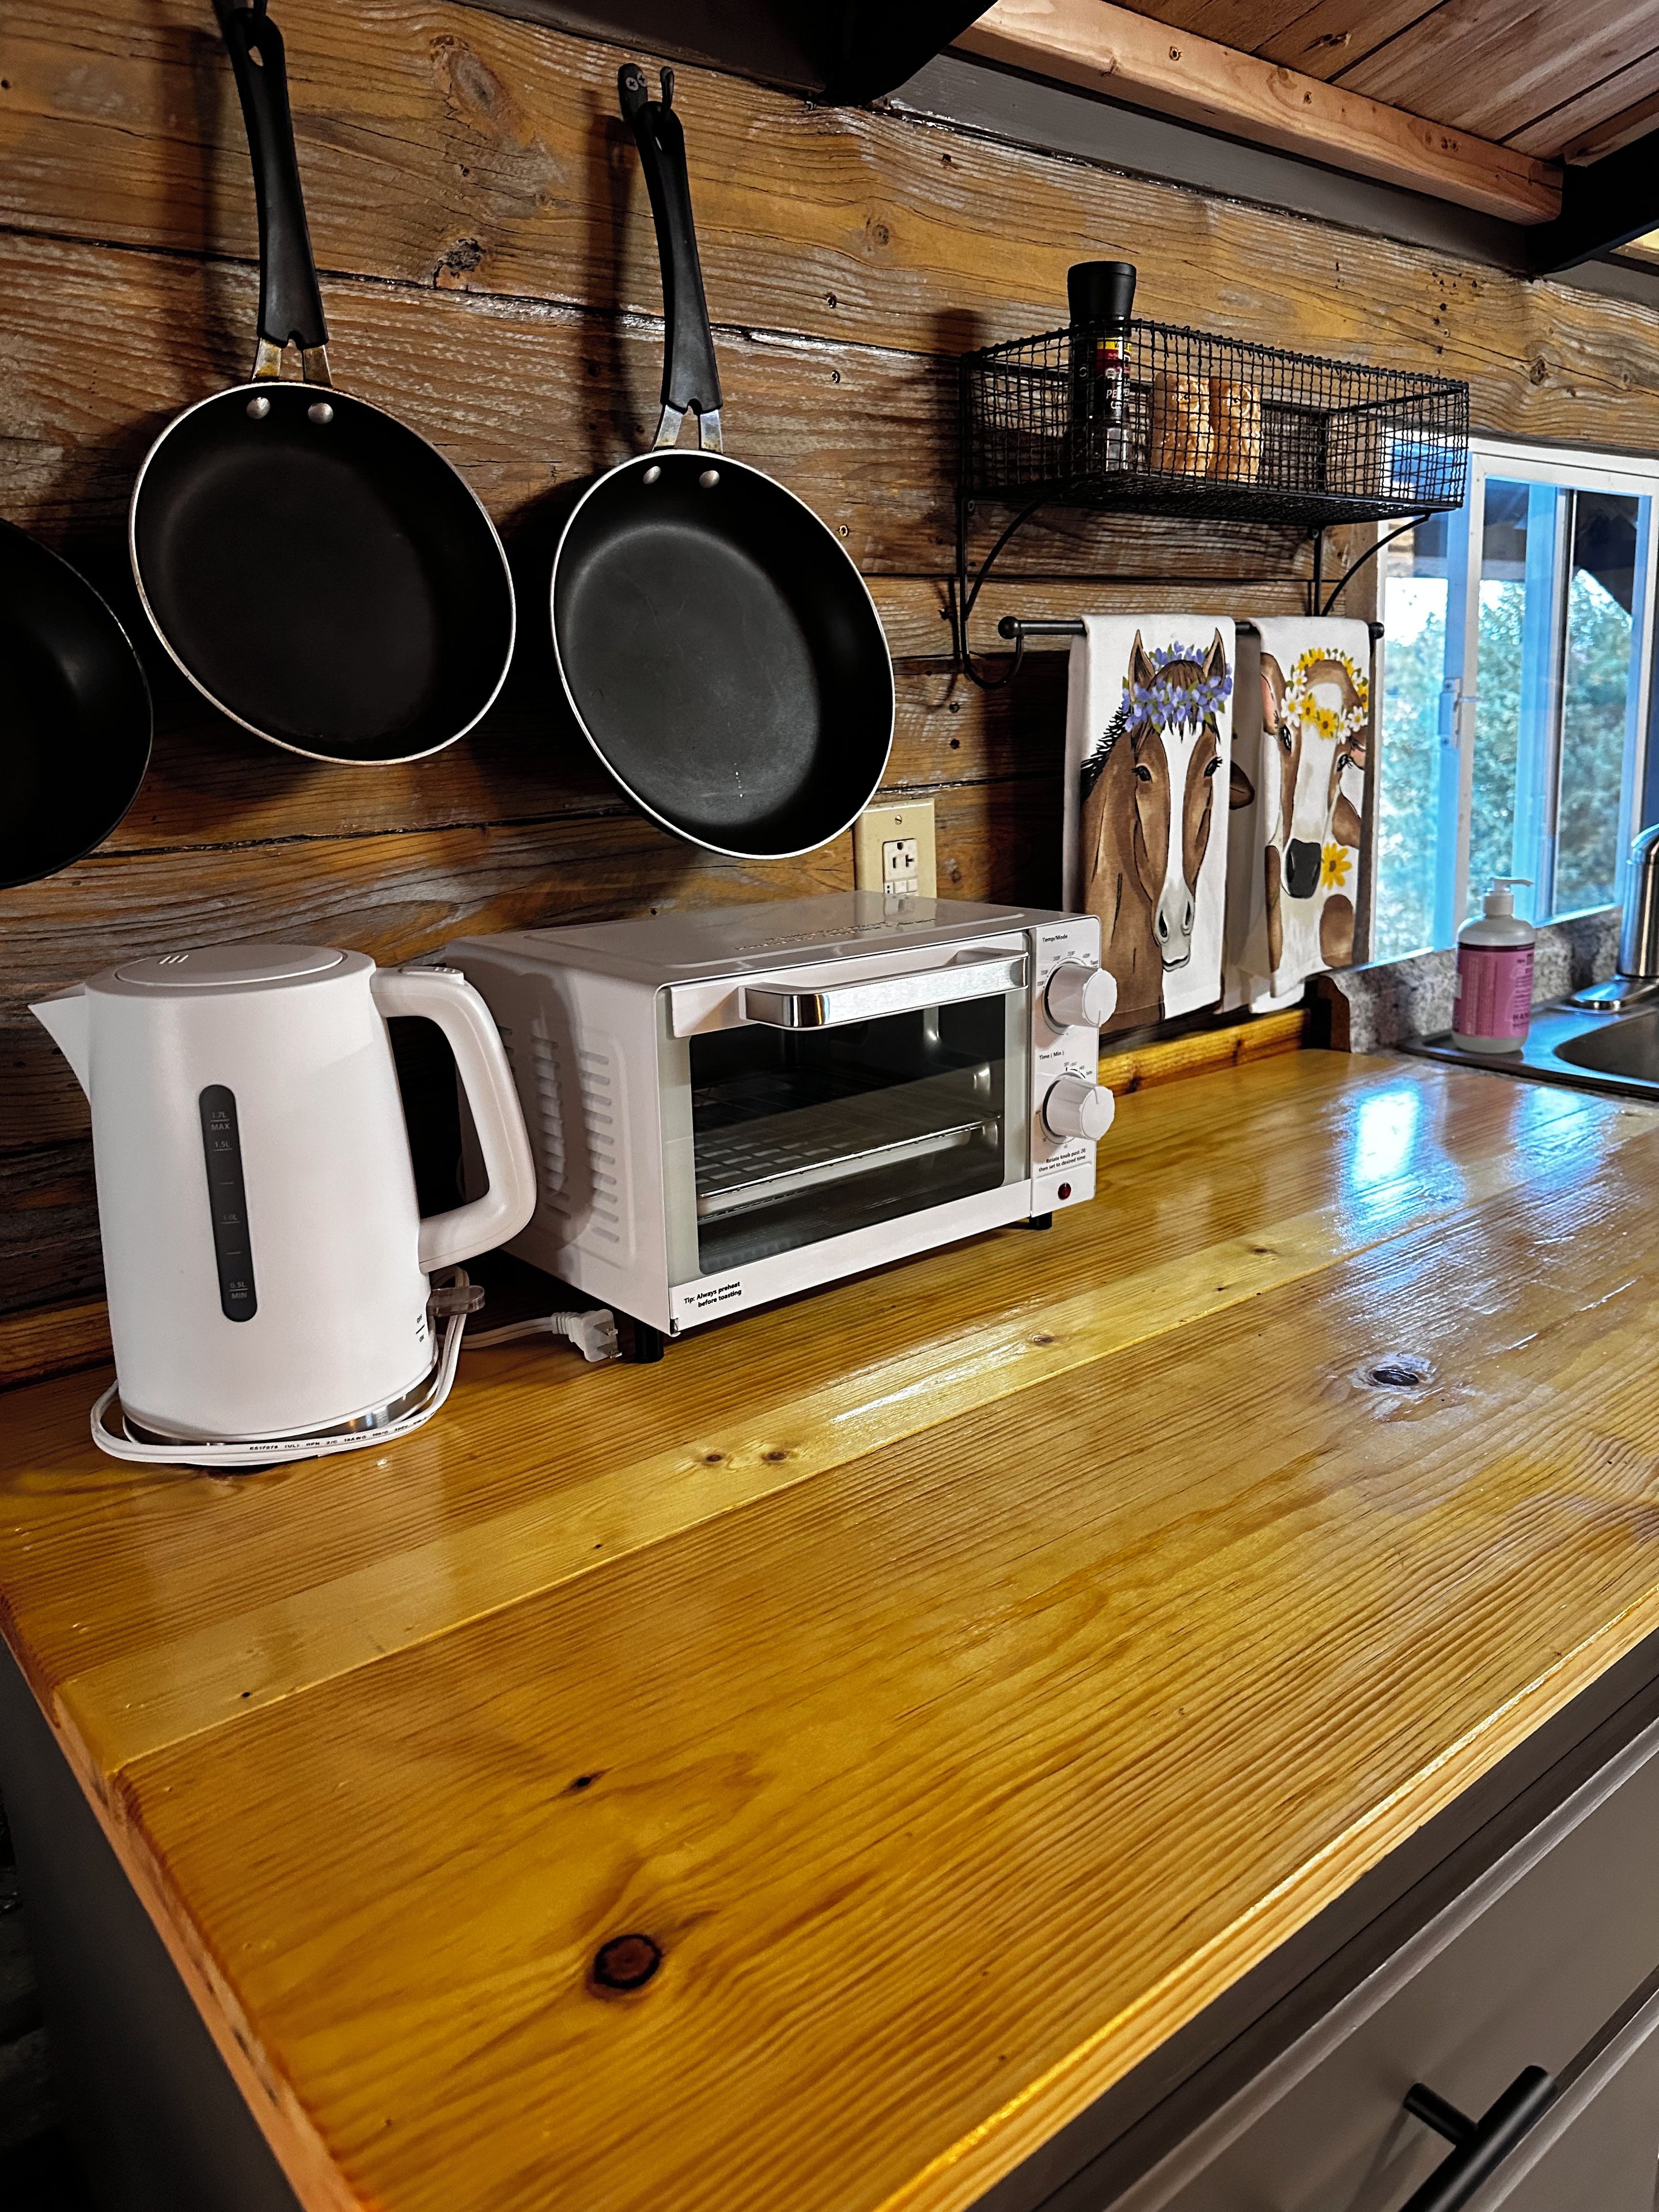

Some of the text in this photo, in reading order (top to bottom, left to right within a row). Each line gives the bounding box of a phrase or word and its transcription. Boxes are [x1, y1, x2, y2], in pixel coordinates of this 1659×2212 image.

[1042, 934, 1068, 942] Temp/Mode
[211, 1123, 230, 1131] MAX
[696, 1289, 717, 1300] Always
[718, 1282, 740, 1294] preheat
[698, 1290, 742, 1308] before toasting
